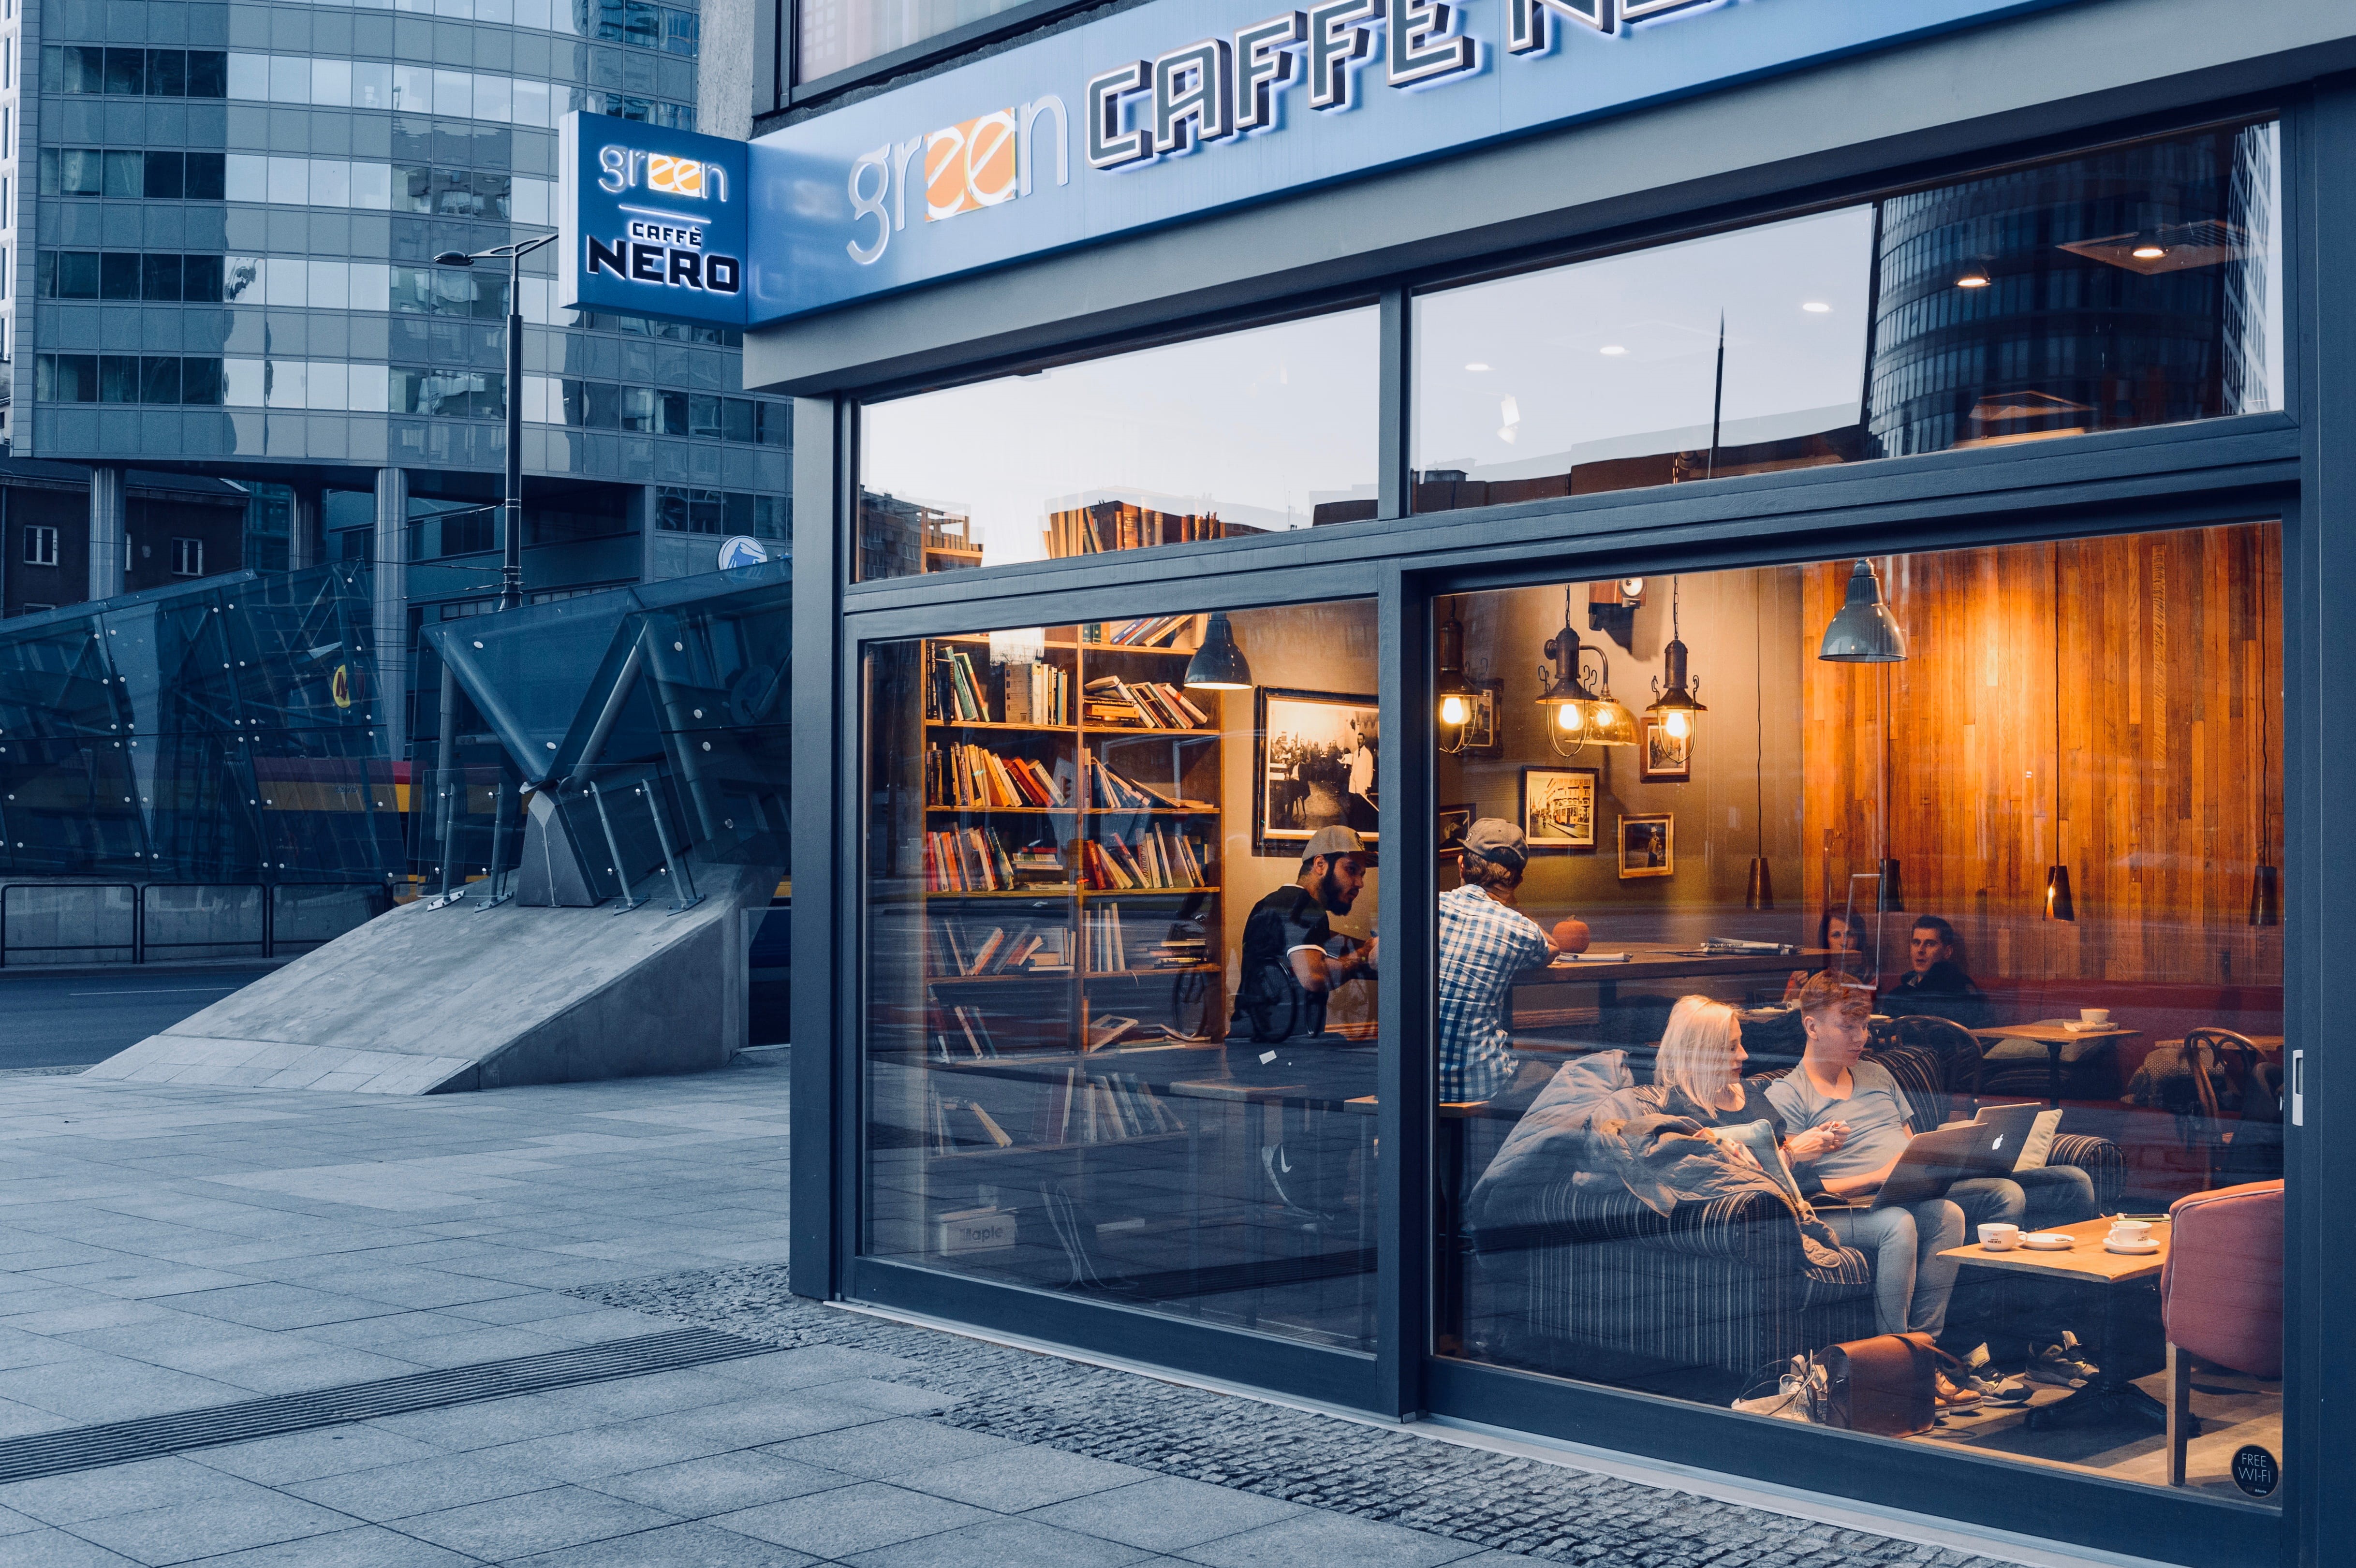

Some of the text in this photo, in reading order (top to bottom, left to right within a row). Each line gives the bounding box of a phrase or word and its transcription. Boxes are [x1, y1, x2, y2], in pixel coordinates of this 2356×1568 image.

[598, 146, 727, 202] green
[846, 95, 1070, 265] green
[586, 235, 740, 294] NERO
[2238, 1466, 2270, 1483] WI-FI
[2242, 1453, 2267, 1467] FREE
